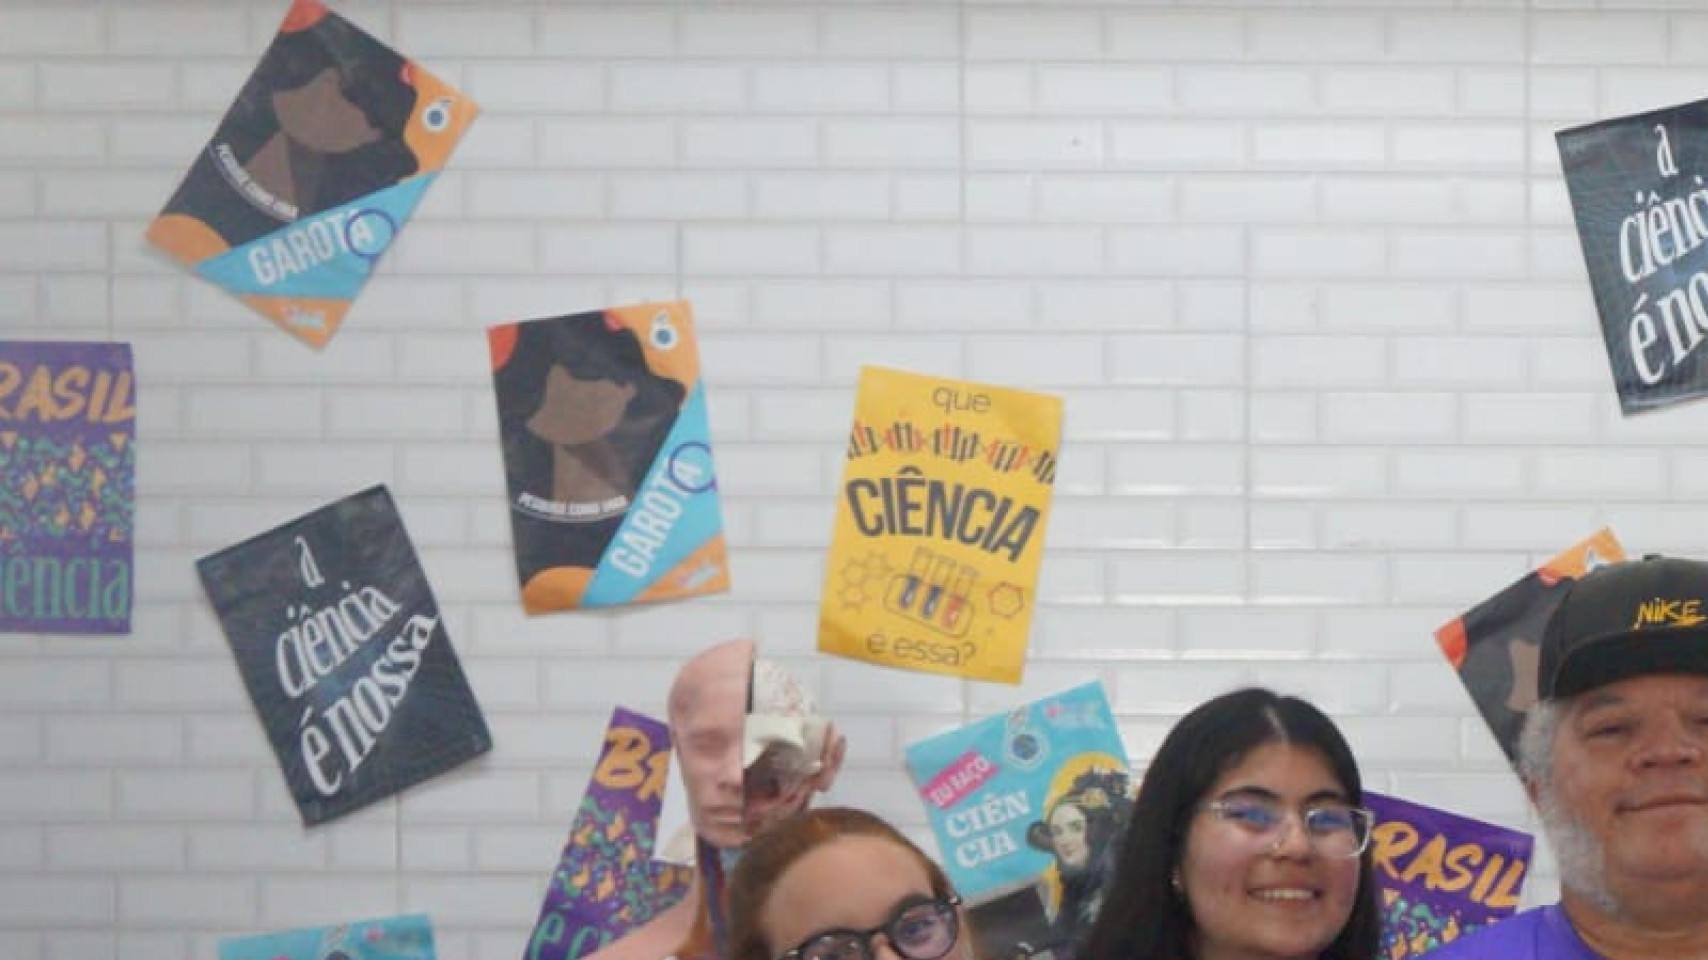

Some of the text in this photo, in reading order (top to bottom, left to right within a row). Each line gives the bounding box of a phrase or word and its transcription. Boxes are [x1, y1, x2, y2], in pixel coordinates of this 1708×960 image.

[248, 208, 375, 286] GAROTA
[1629, 291, 1665, 385] é
[931, 386, 992, 415] que
[608, 455, 703, 578] GAROTA
[845, 465, 1041, 563] CIÊNCIA
[275, 580, 402, 698] ciência
[893, 637, 976, 666] essa?
[300, 614, 438, 796] é nossa
[945, 790, 1030, 838] CIÊN
[956, 831, 1020, 868] CIA
